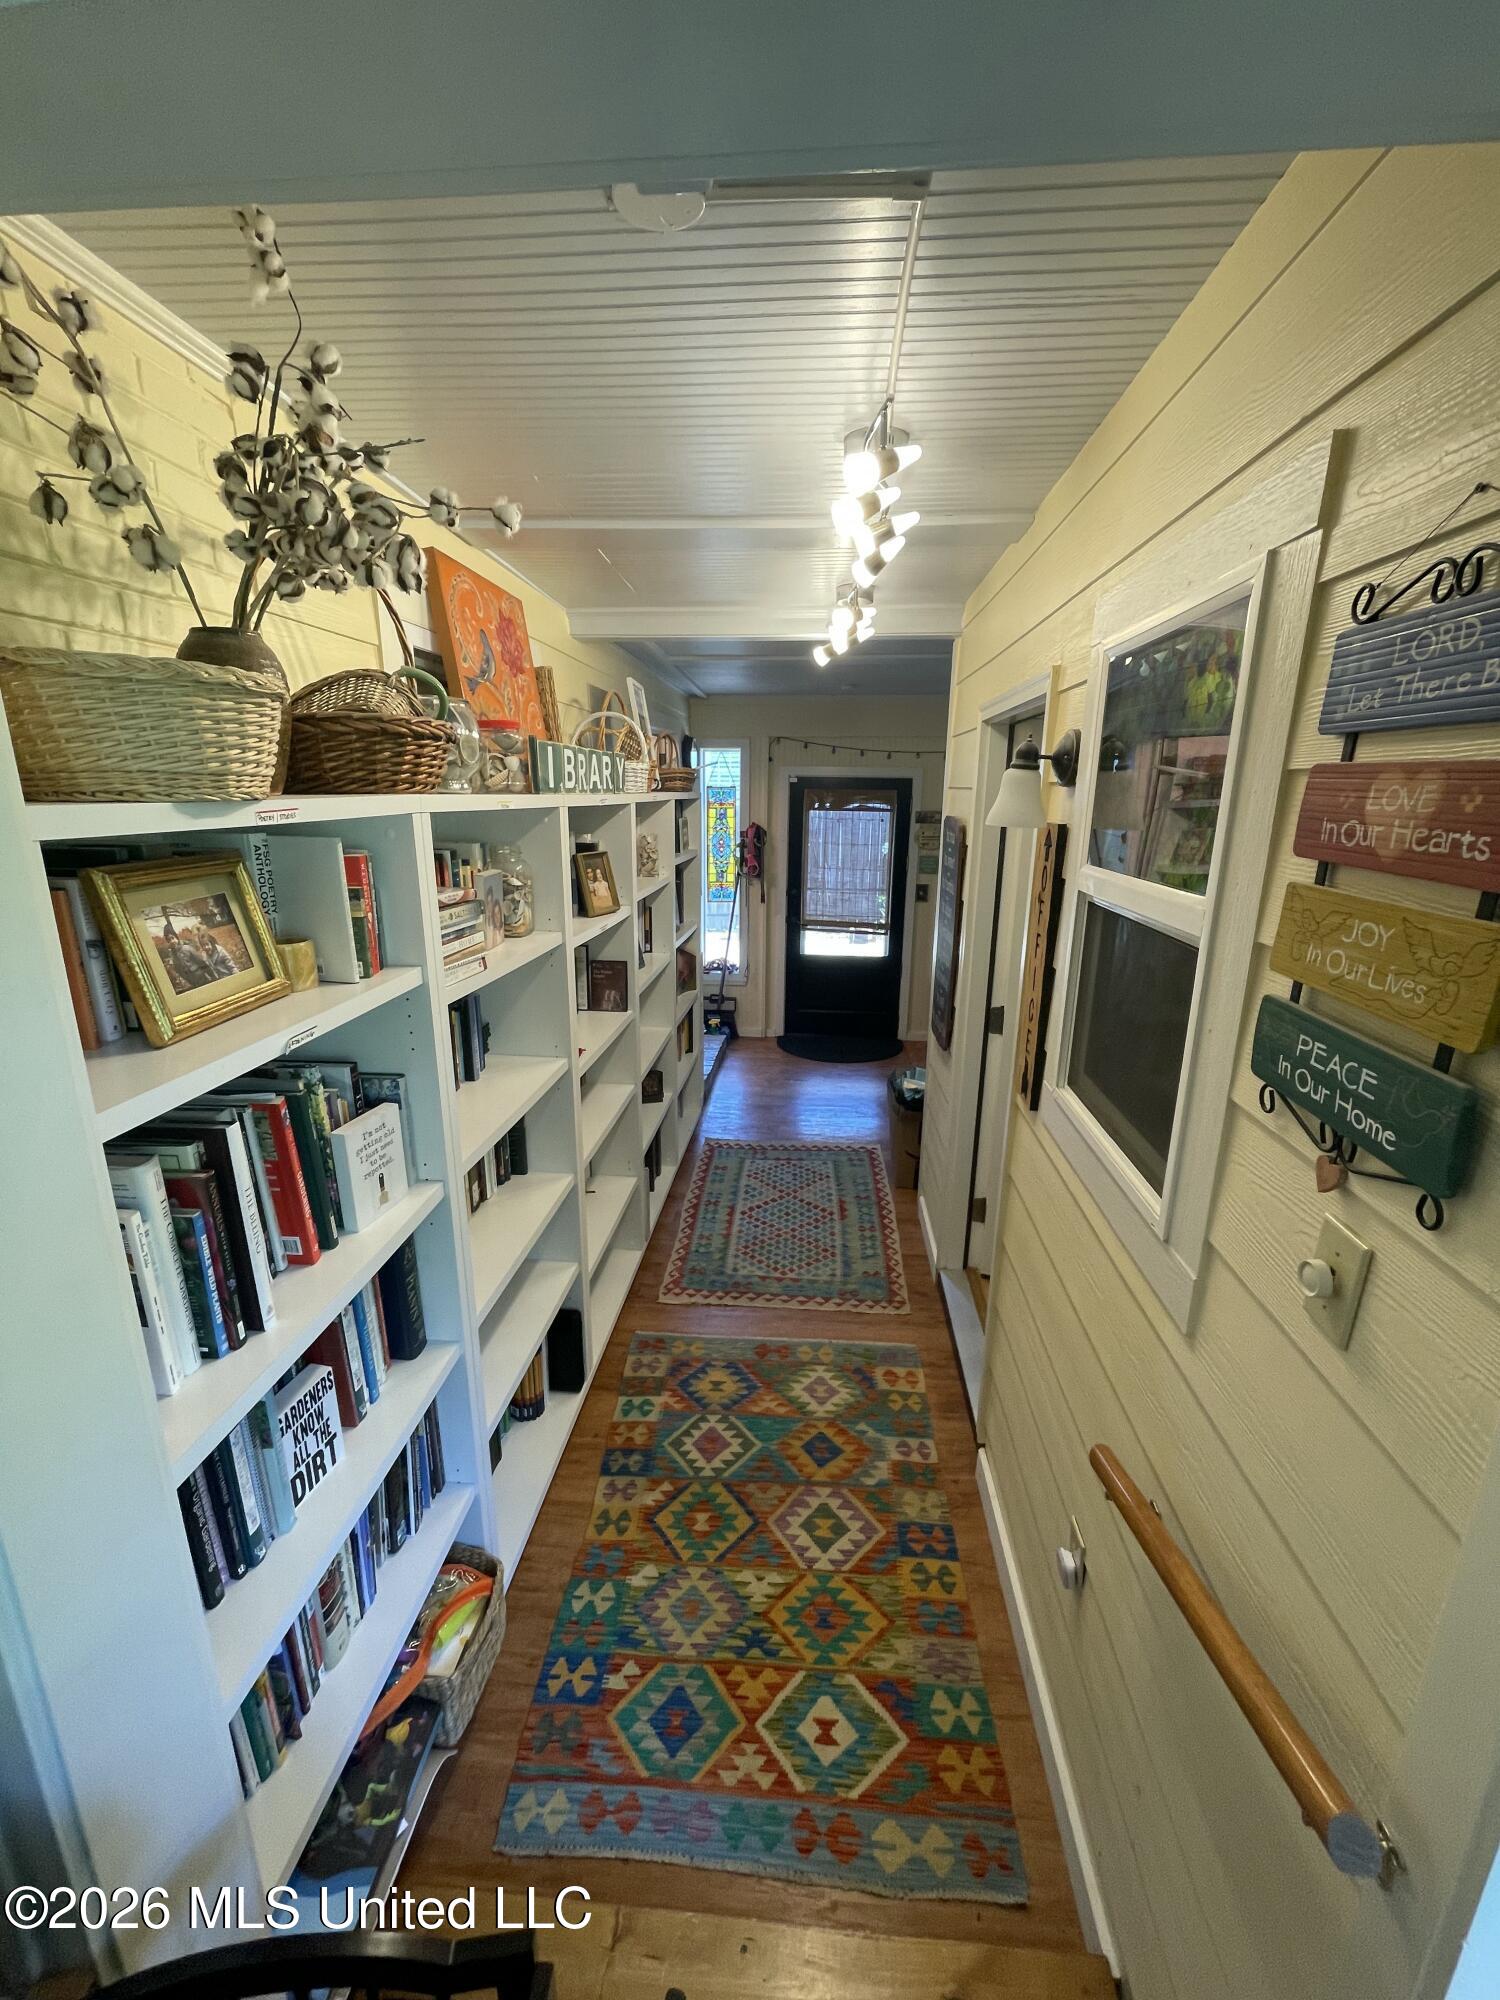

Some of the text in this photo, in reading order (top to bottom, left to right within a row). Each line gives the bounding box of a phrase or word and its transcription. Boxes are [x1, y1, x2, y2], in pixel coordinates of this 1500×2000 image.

[1391, 617, 1485, 667] LORD,
[1346, 686, 1384, 713] Let
[1392, 666, 1472, 704] There
[1365, 784, 1438, 813] LOVE
[262, 844, 271, 867] FSG
[1341, 820, 1386, 848] Our
[1390, 820, 1492, 862] Hearts
[253, 845, 271, 915] ANTHOLOGY
[266, 870, 278, 914] POETRY
[1342, 919, 1396, 951] JOY
[1025, 865, 1048, 1057] OFFICE
[1327, 950, 1369, 981] Our
[1368, 965, 1428, 1004] Lives
[1296, 1033, 1378, 1101] PEACE
[374, 1122, 386, 1133] not
[384, 1127, 395, 1139] old
[1295, 1069, 1330, 1104] Our
[1335, 1088, 1397, 1151] Home
[369, 1158, 378, 1166] to
[160, 1198, 172, 1221] THE
[166, 1222, 184, 1279] COMPLETE
[201, 1233, 223, 1324] EDIBLE WILD PLANTS
[278, 1370, 334, 1438] GARDENERS
[292, 1402, 324, 1449] KNOW
[293, 1416, 333, 1473] ALL THE
[290, 1432, 337, 1508] DIRT
